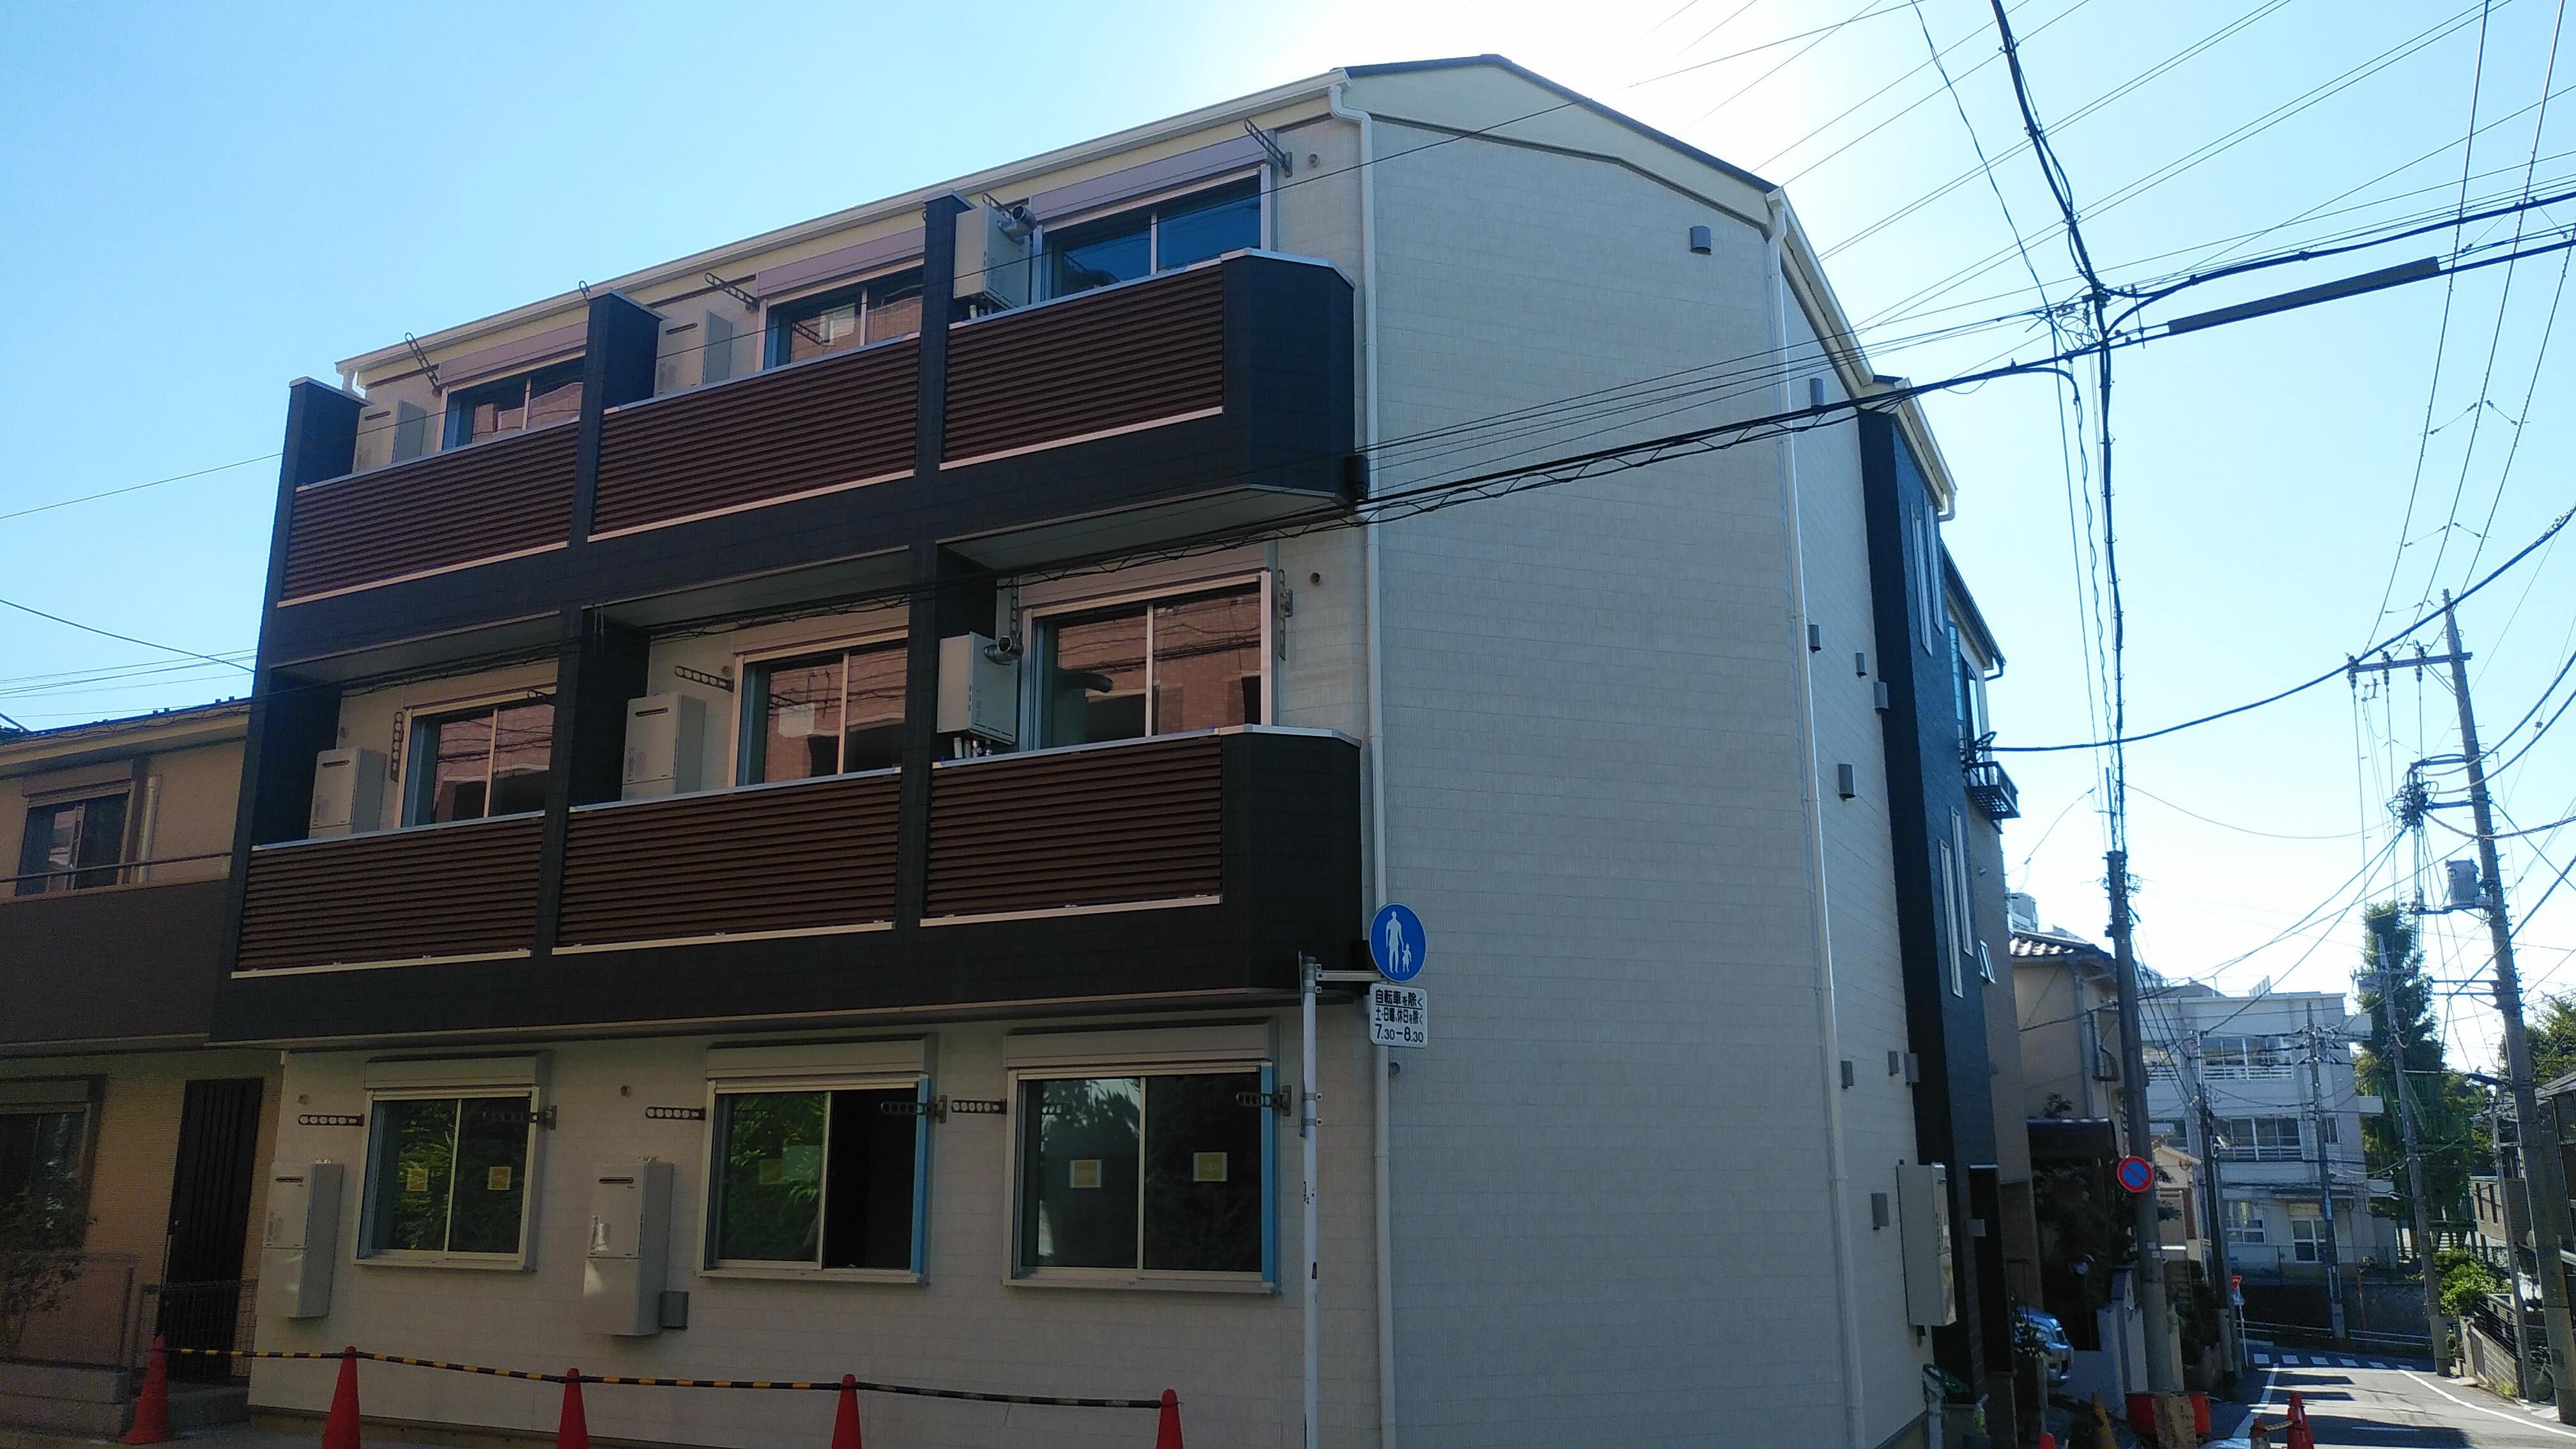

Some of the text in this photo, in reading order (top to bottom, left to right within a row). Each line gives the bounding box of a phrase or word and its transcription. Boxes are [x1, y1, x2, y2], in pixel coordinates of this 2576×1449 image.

[1376, 989, 1423, 1008] 自転車を除く
